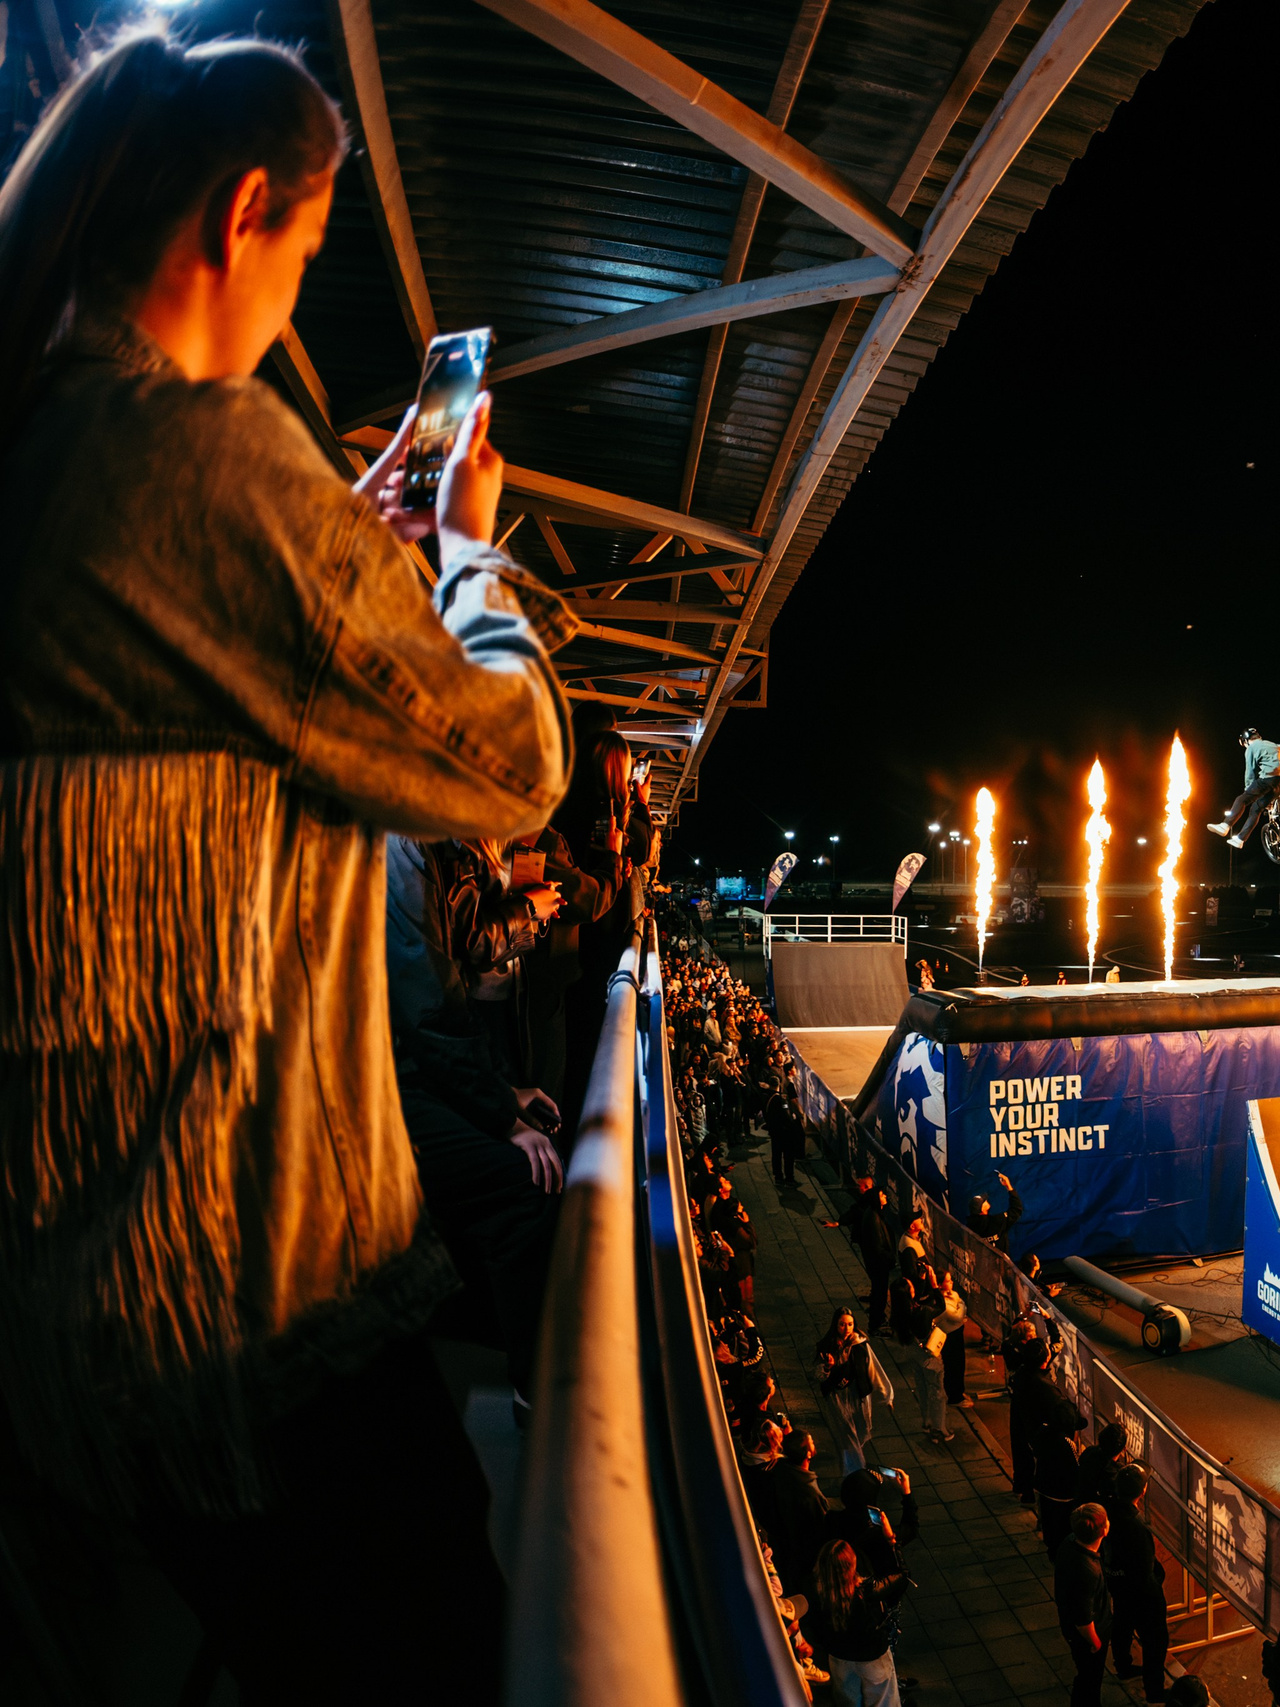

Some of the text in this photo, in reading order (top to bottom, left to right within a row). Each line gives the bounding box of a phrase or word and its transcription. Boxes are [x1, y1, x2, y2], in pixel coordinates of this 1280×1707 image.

[989, 1074, 1082, 1106] POWER
[989, 1102, 1060, 1132] YOUR
[990, 1124, 1110, 1158] INSTINCT
